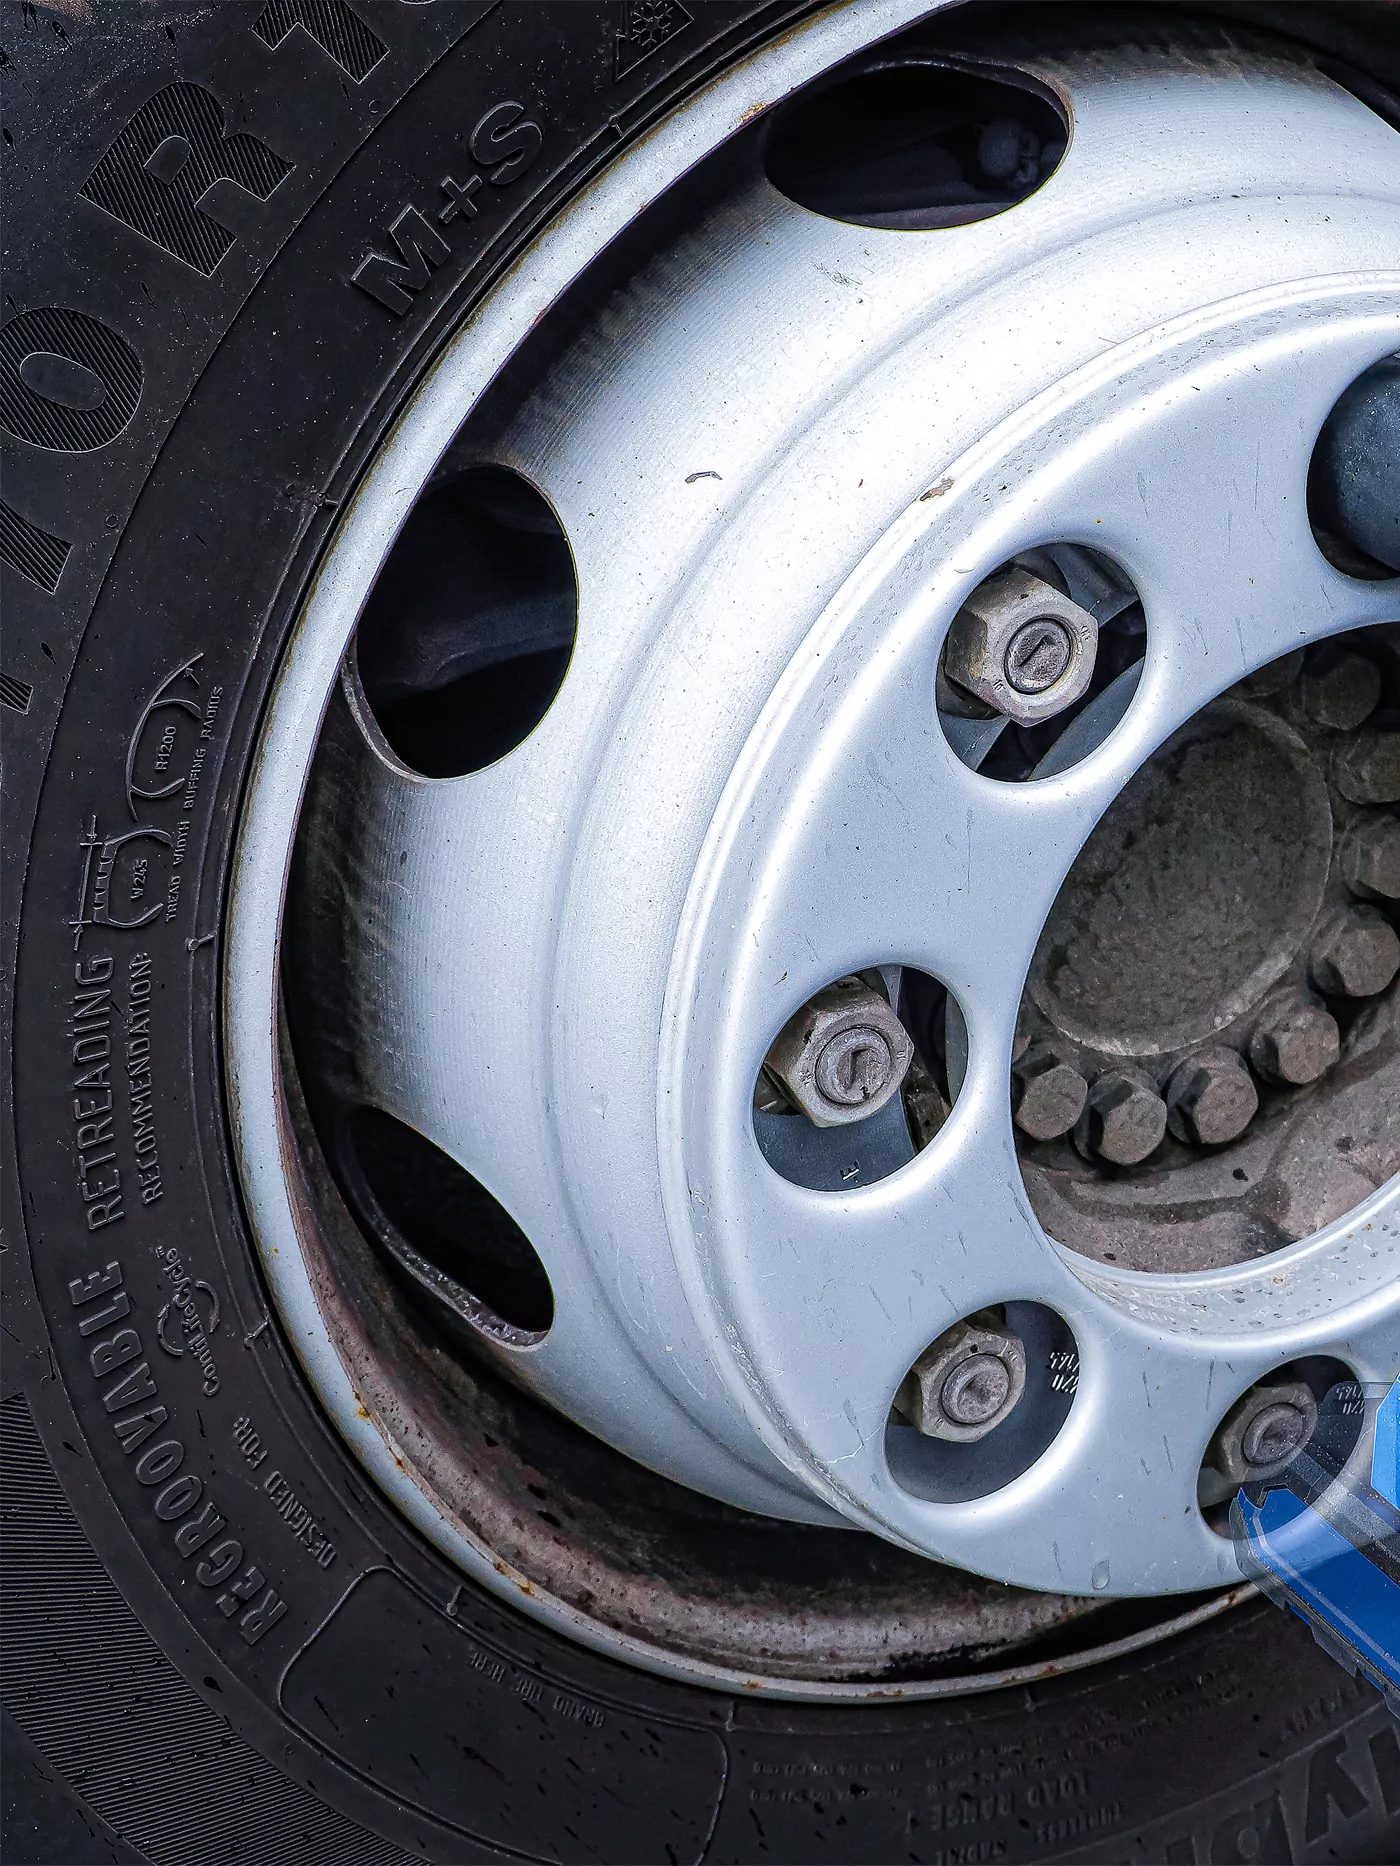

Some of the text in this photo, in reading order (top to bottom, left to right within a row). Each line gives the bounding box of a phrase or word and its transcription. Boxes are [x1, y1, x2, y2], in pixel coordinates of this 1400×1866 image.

[349, 99, 545, 316] M+S
[165, 685, 224, 924] TREAD WIDTH BUFFING RADIUS
[73, 954, 126, 1230] RETREADING
[68, 1260, 288, 1646] REGROOVABLE
[260, 1470, 339, 1570] DESIGNED
